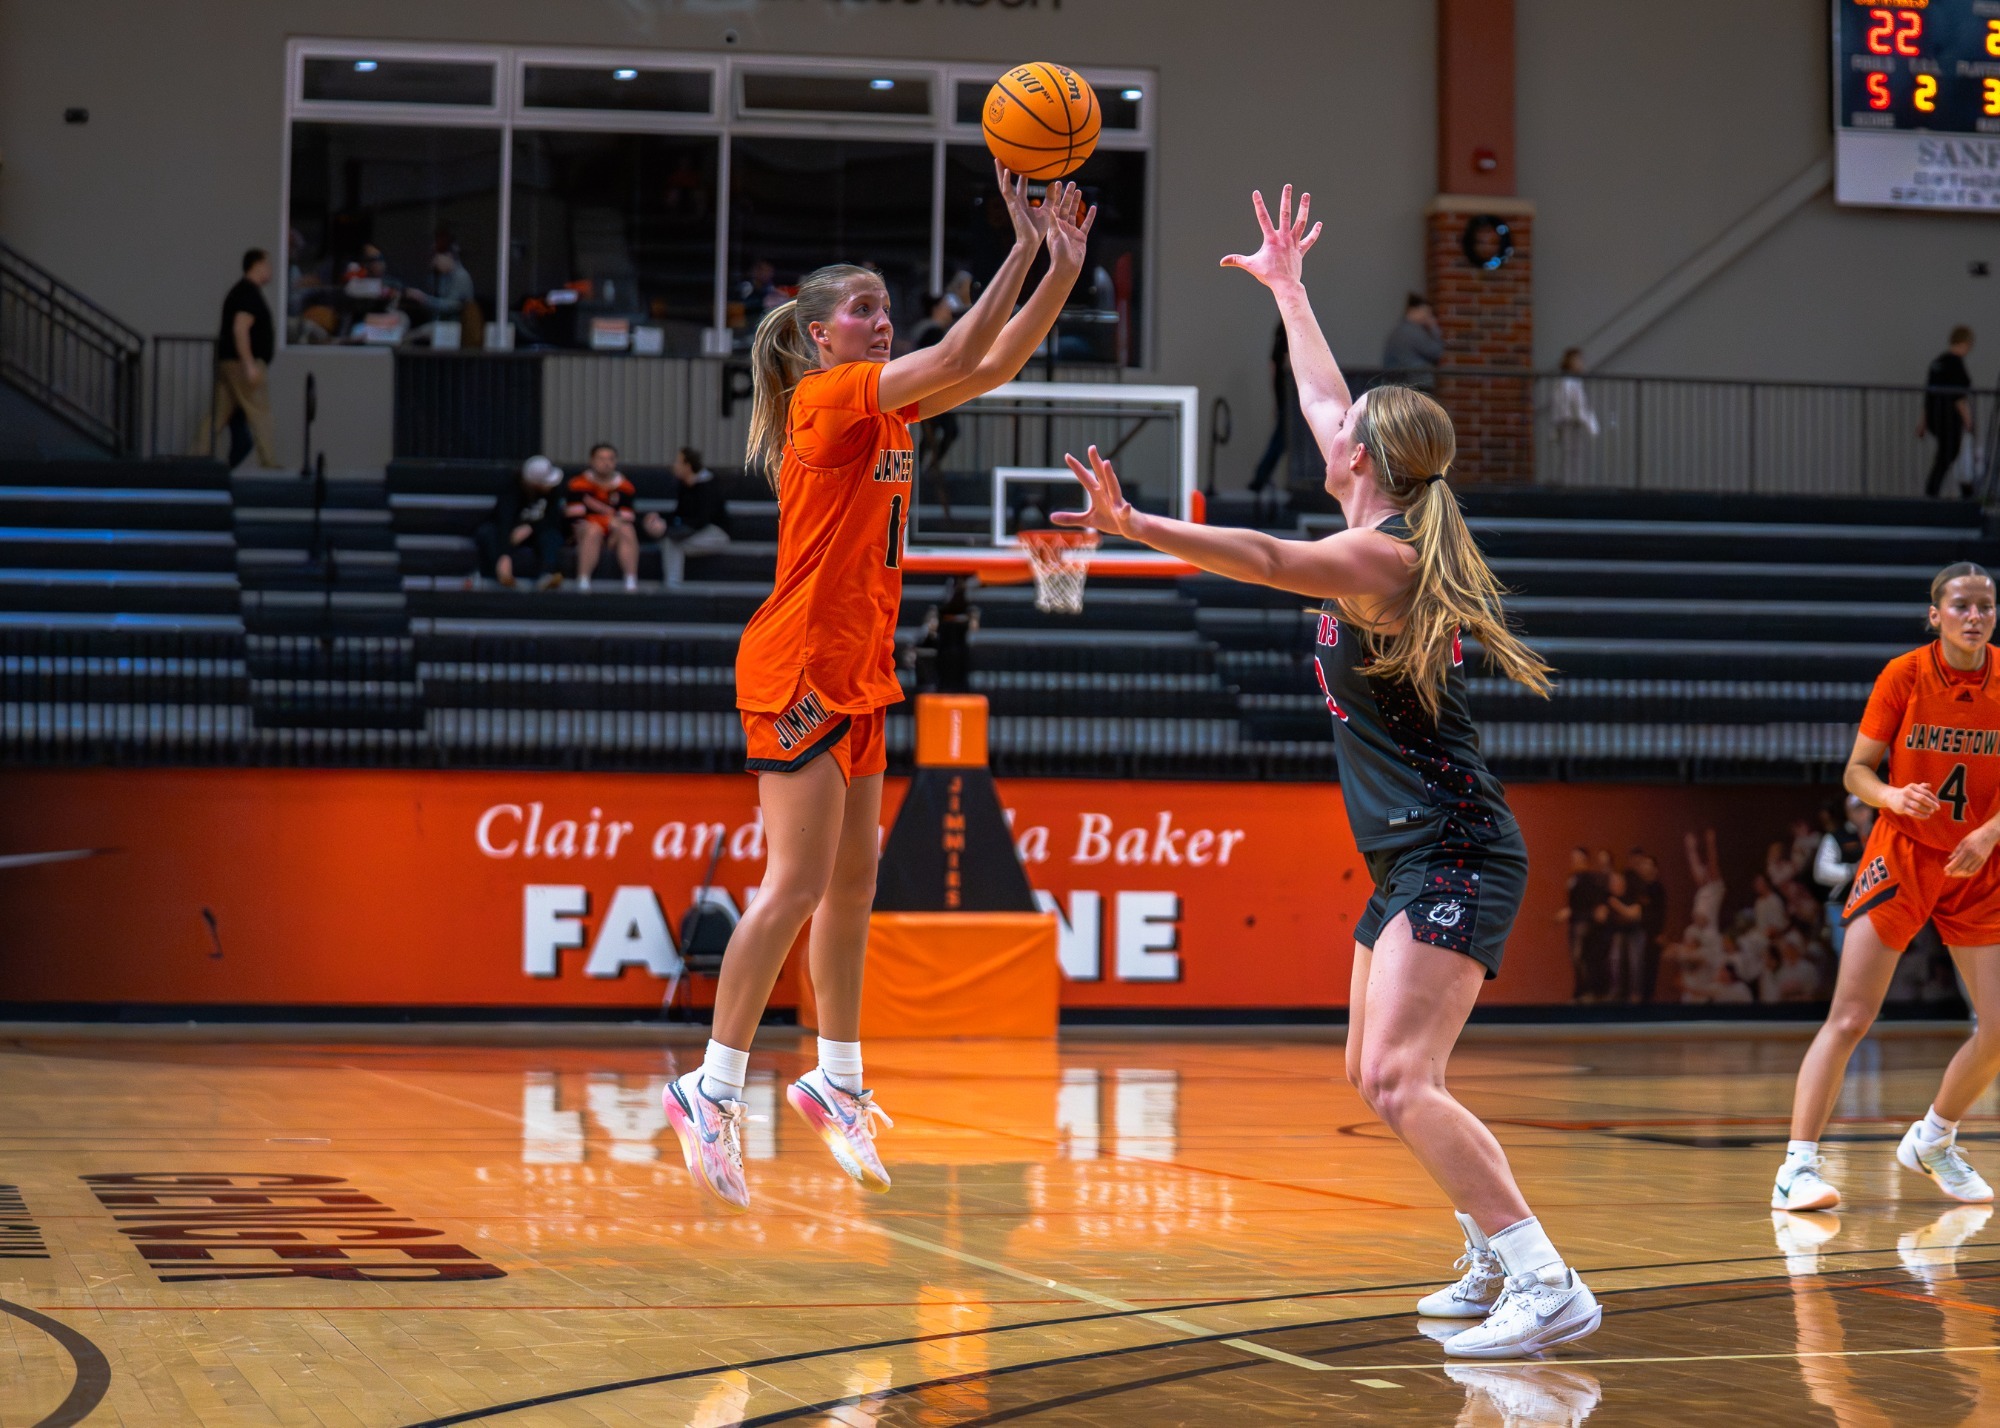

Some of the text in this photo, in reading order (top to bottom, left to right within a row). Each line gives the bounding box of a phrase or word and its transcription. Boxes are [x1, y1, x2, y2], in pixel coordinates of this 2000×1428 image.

[1867, 9, 1923, 56] 22
[1010, 68, 1045, 94] EVO
[1866, 71, 1891, 110] 5
[1913, 74, 1938, 113] 2
[773, 690, 835, 750] JIMMI
[1906, 723, 2000, 756] JAMESTOW
[1936, 763, 1968, 822] 4
[474, 800, 767, 860] Clair and
[942, 776, 966, 909] JIMMIES
[1071, 810, 1246, 866] Baker
[1031, 889, 1181, 982] NE
[78, 1171, 508, 1282] GIENGER
